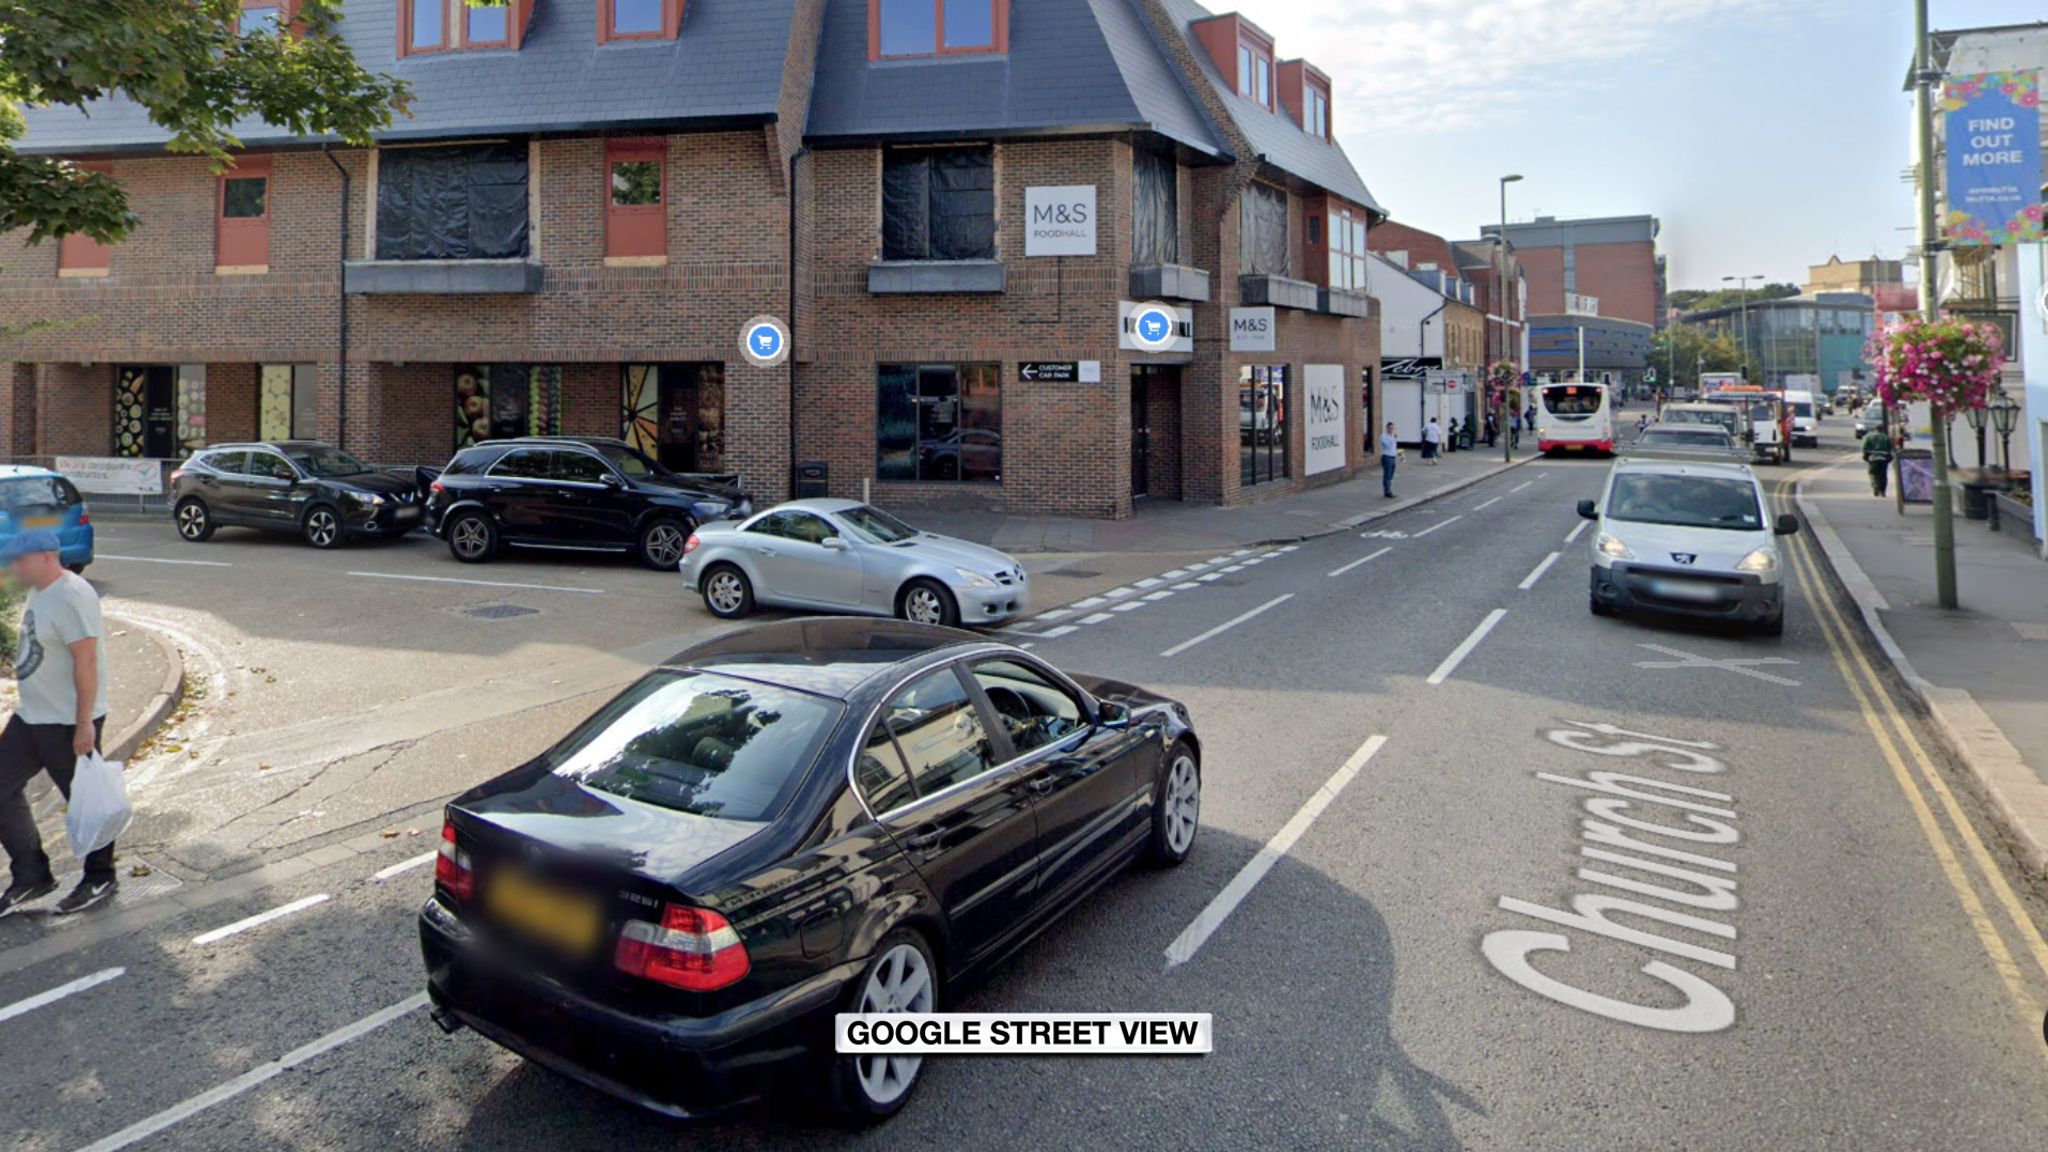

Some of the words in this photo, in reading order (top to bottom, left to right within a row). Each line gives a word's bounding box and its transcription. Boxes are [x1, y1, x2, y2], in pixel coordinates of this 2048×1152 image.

[1968, 116, 2015, 132] FIND
[1970, 134, 2014, 149] OUT
[1962, 150, 2023, 166] MORE
[1033, 203, 1087, 224] M&S
[1033, 230, 1087, 238] FOODHALL
[1234, 318, 1268, 332] M&S
[1038, 364, 1073, 372] CUSTOMER
[1310, 384, 1339, 425] M&S
[1545, 717, 1728, 774] St
[1481, 770, 1740, 1033] Church
